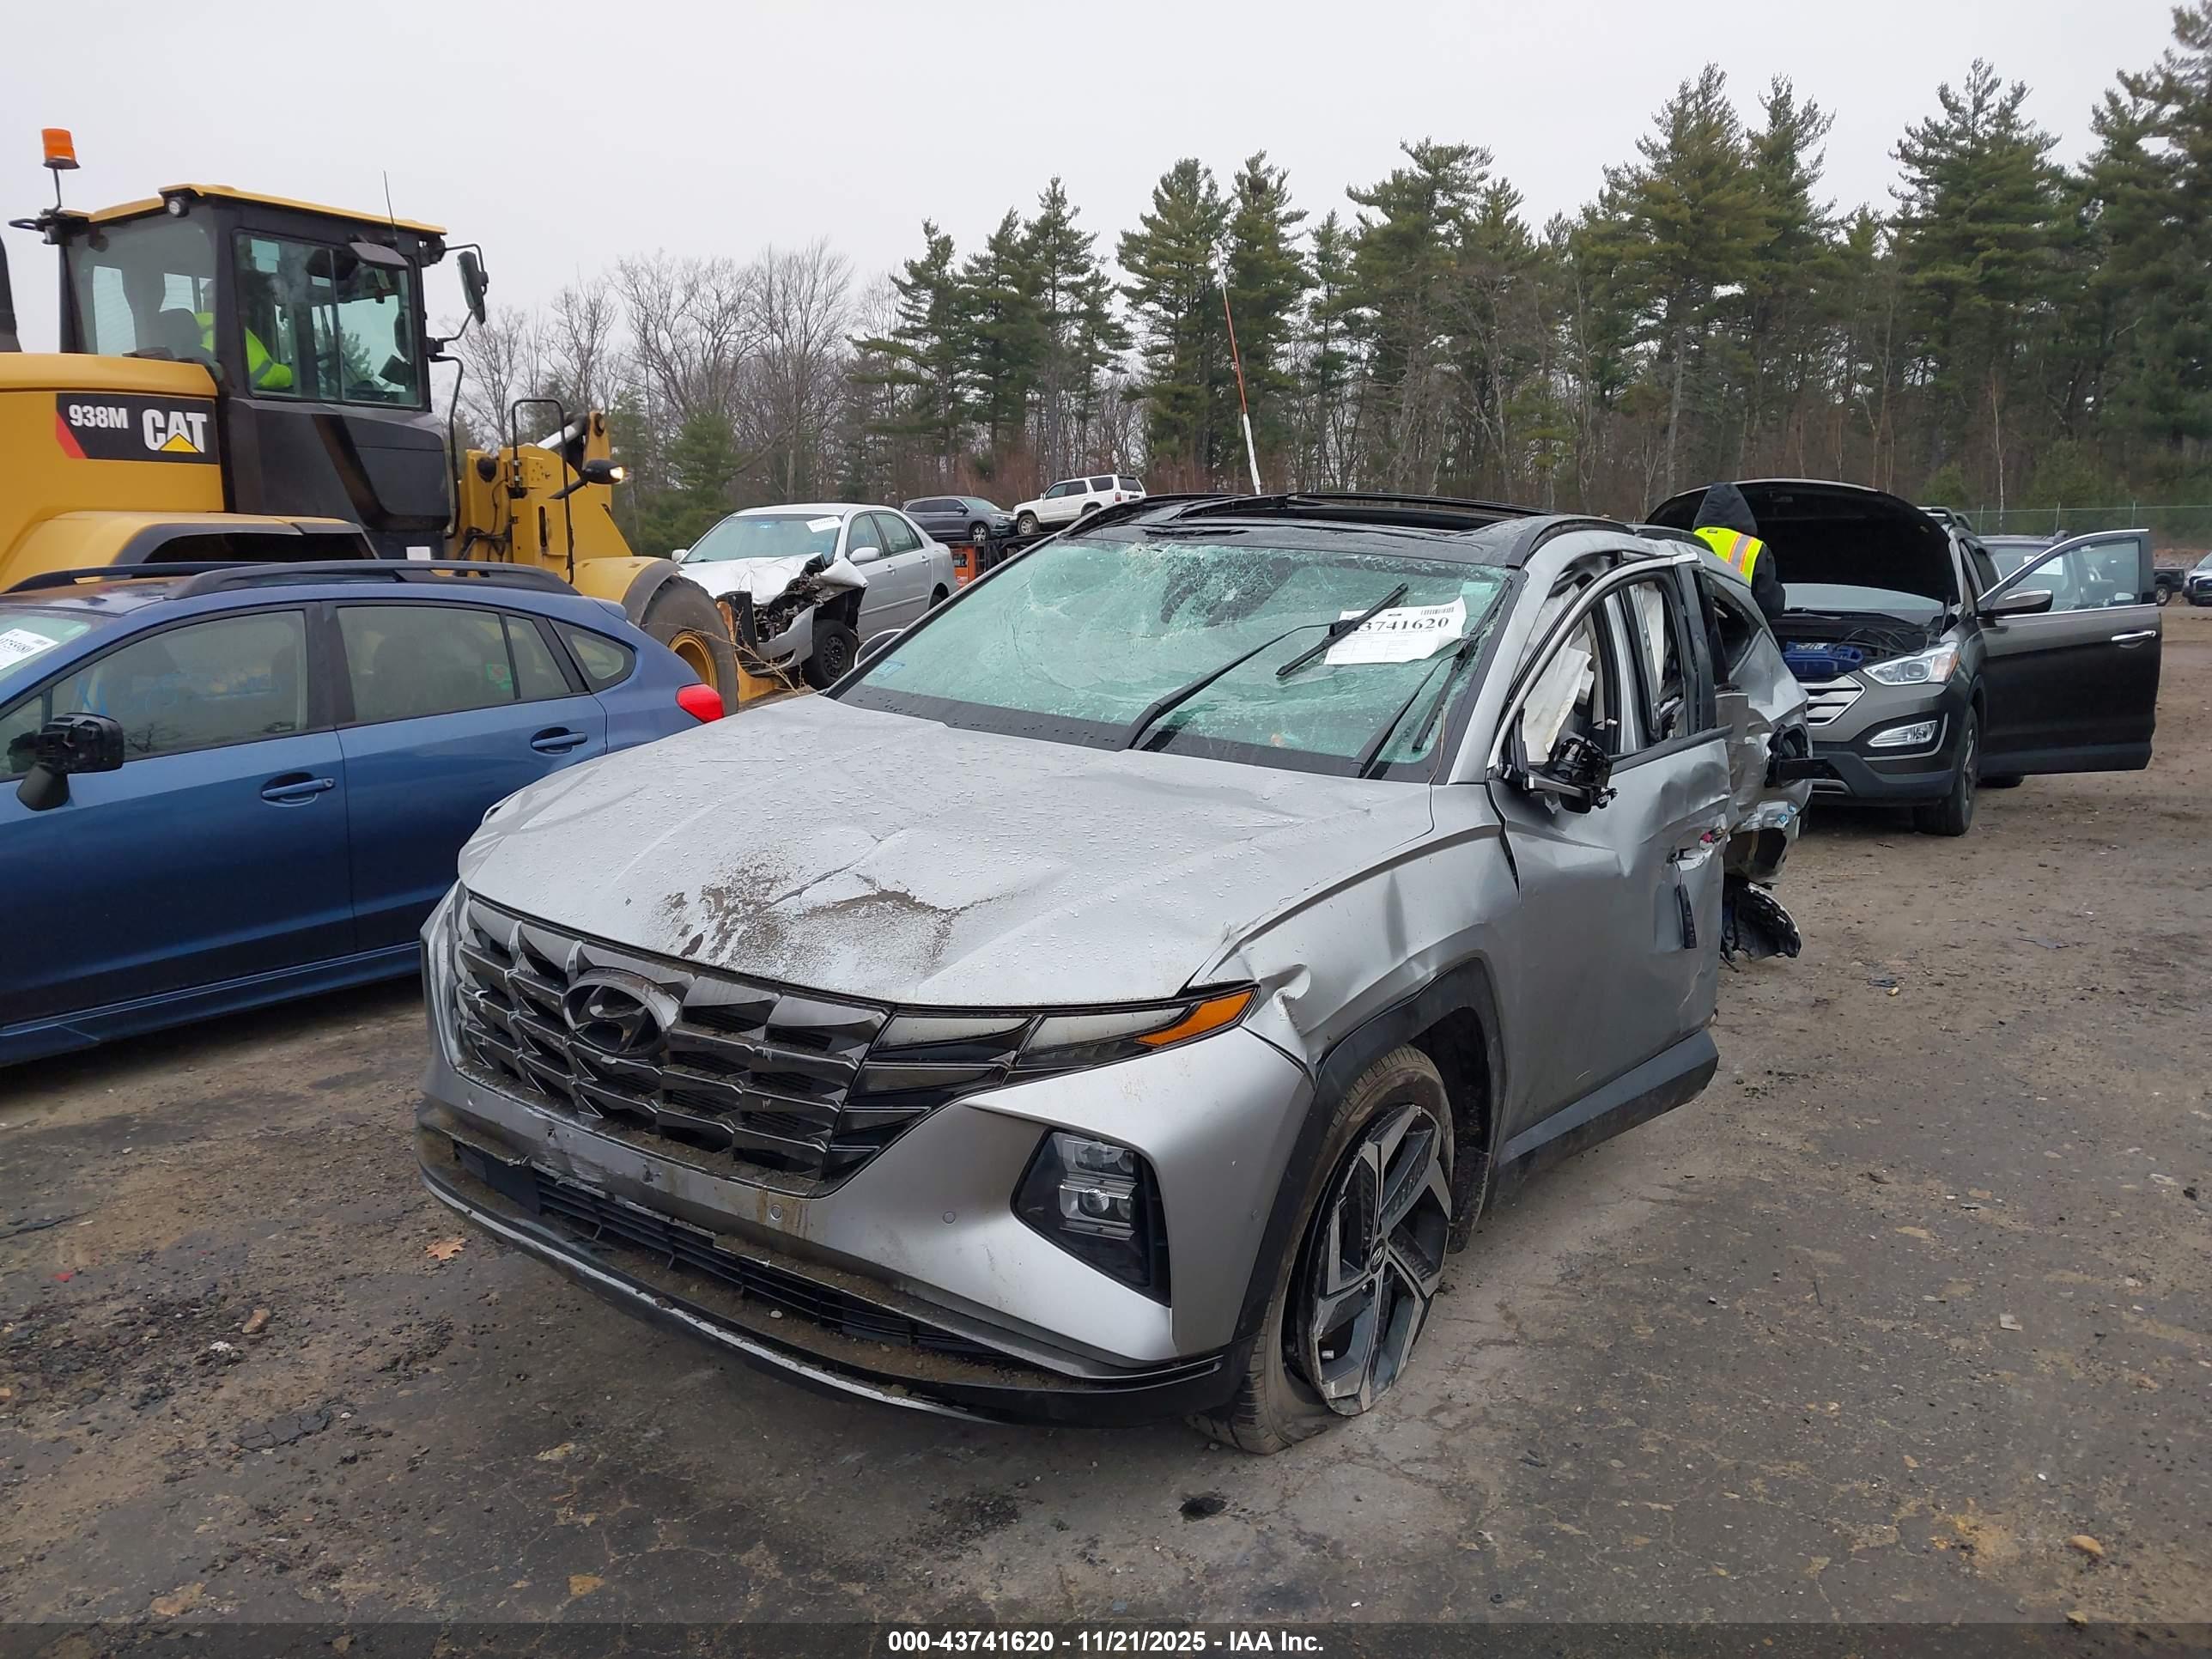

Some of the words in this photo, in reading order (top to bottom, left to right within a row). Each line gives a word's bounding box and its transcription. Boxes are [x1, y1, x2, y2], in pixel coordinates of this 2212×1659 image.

[69, 404, 129, 429] 938M
[142, 409, 207, 453] CAT
[1354, 617, 1449, 632] 3741620
